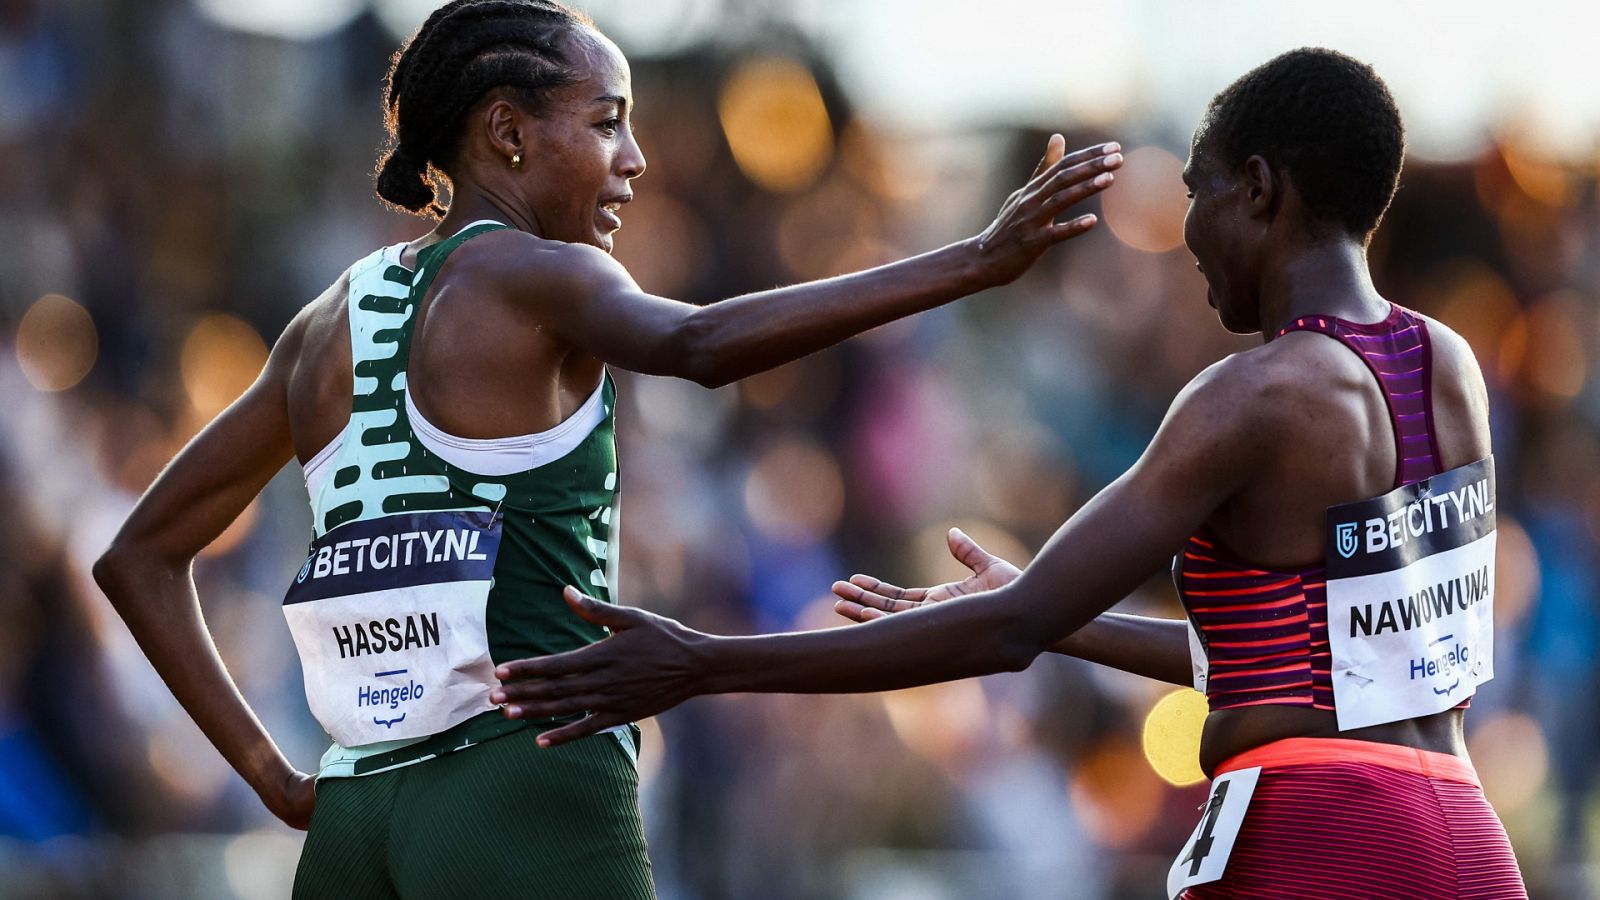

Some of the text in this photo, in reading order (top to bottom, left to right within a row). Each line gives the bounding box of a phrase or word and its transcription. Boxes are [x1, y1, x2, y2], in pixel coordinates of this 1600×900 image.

[1365, 478, 1493, 554] BETCITY.NL
[312, 529, 487, 579] BETCITY.NL
[1350, 565, 1489, 638] NAWOWUNA
[332, 612, 440, 659] HASSAN
[1410, 643, 1469, 680] Hengelo
[358, 679, 424, 709] Hengelo
[1180, 779, 1231, 878] 4
